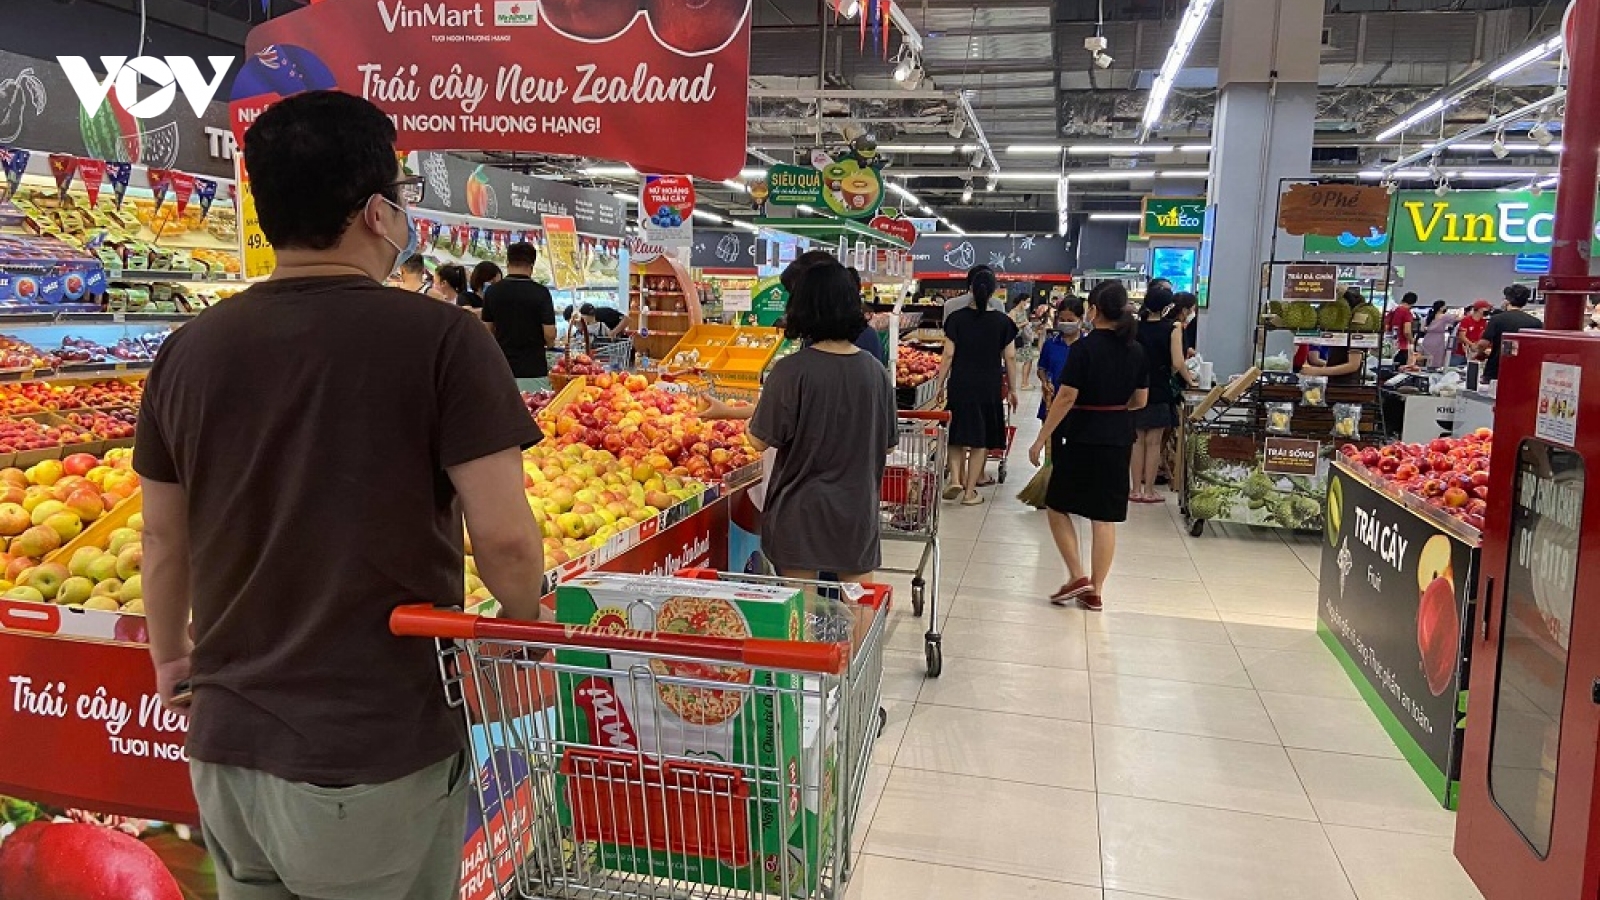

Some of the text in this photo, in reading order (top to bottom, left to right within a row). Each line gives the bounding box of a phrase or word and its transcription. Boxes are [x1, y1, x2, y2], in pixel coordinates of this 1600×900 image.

[377, 0, 484, 33] VinMart
[357, 62, 716, 113] Trái cây New Zealand
[402, 114, 456, 132] NGON
[541, 116, 602, 138] HẠNG!
[1157, 213, 1200, 227] VinEco
[1403, 202, 1556, 244] VinEc
[1354, 505, 1409, 573] TRÁI CÂY
[1366, 563, 1382, 593] Fruit
[8, 674, 68, 719] Trái
[76, 685, 132, 735] cây
[109, 736, 189, 762] TƯƠI NGO
